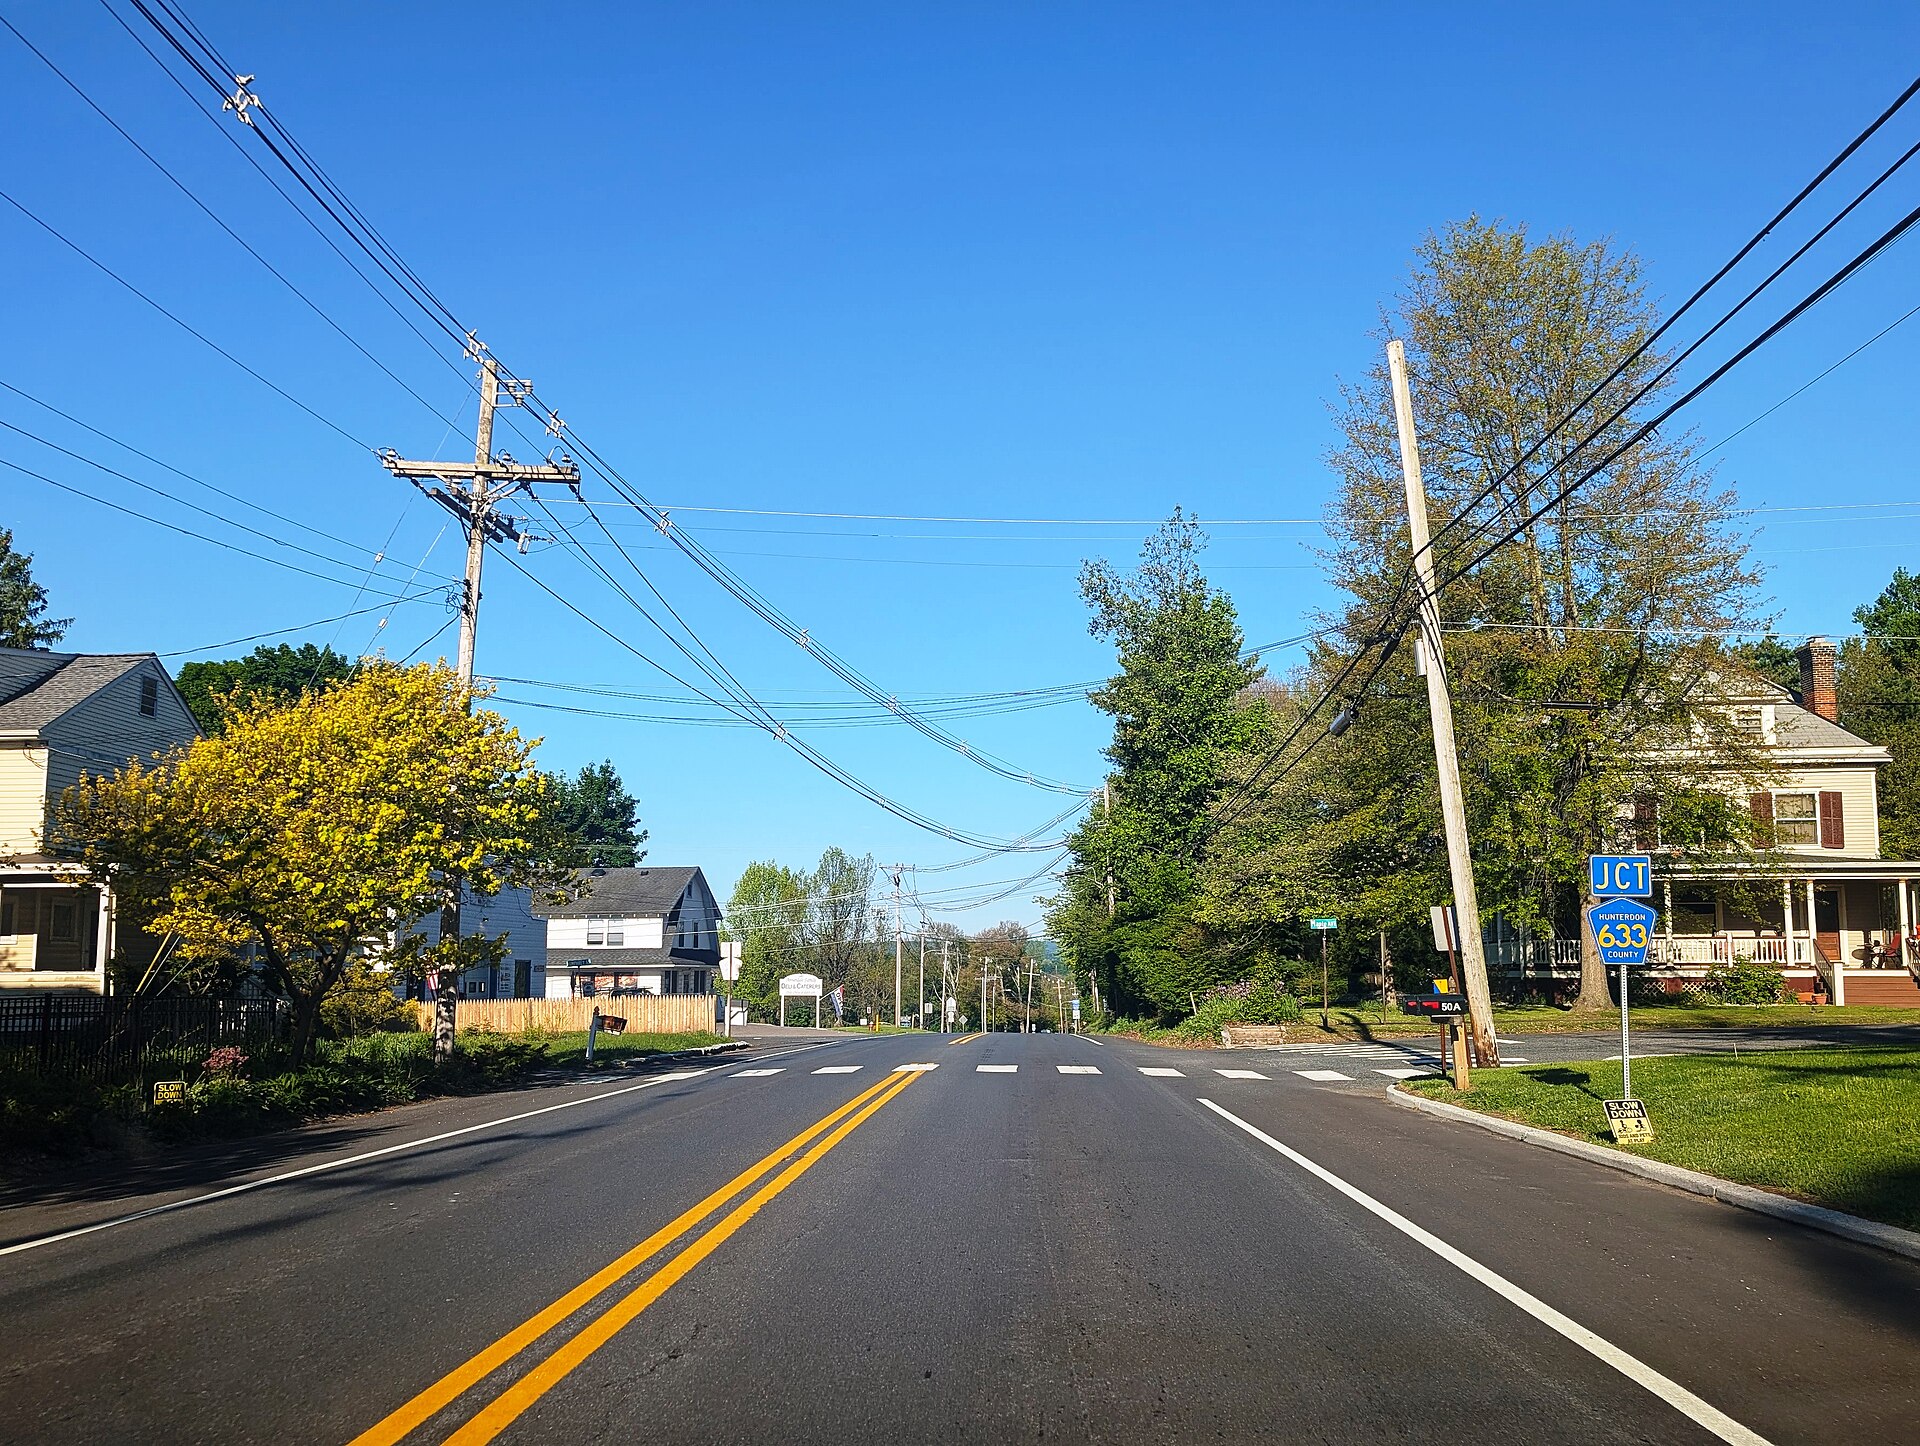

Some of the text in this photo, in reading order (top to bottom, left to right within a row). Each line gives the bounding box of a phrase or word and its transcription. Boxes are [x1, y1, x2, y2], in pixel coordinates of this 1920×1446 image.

[1595, 862, 1647, 889] JCT
[1598, 913, 1646, 921] HUNTERDON
[1598, 923, 1647, 948] 633
[1607, 950, 1639, 958] COUNTY
[1441, 1002, 1461, 1011] 50A
[157, 1091, 182, 1099] DOWN
[1608, 1101, 1638, 1110] SLOW
[1610, 1109, 1643, 1118] DOWN
